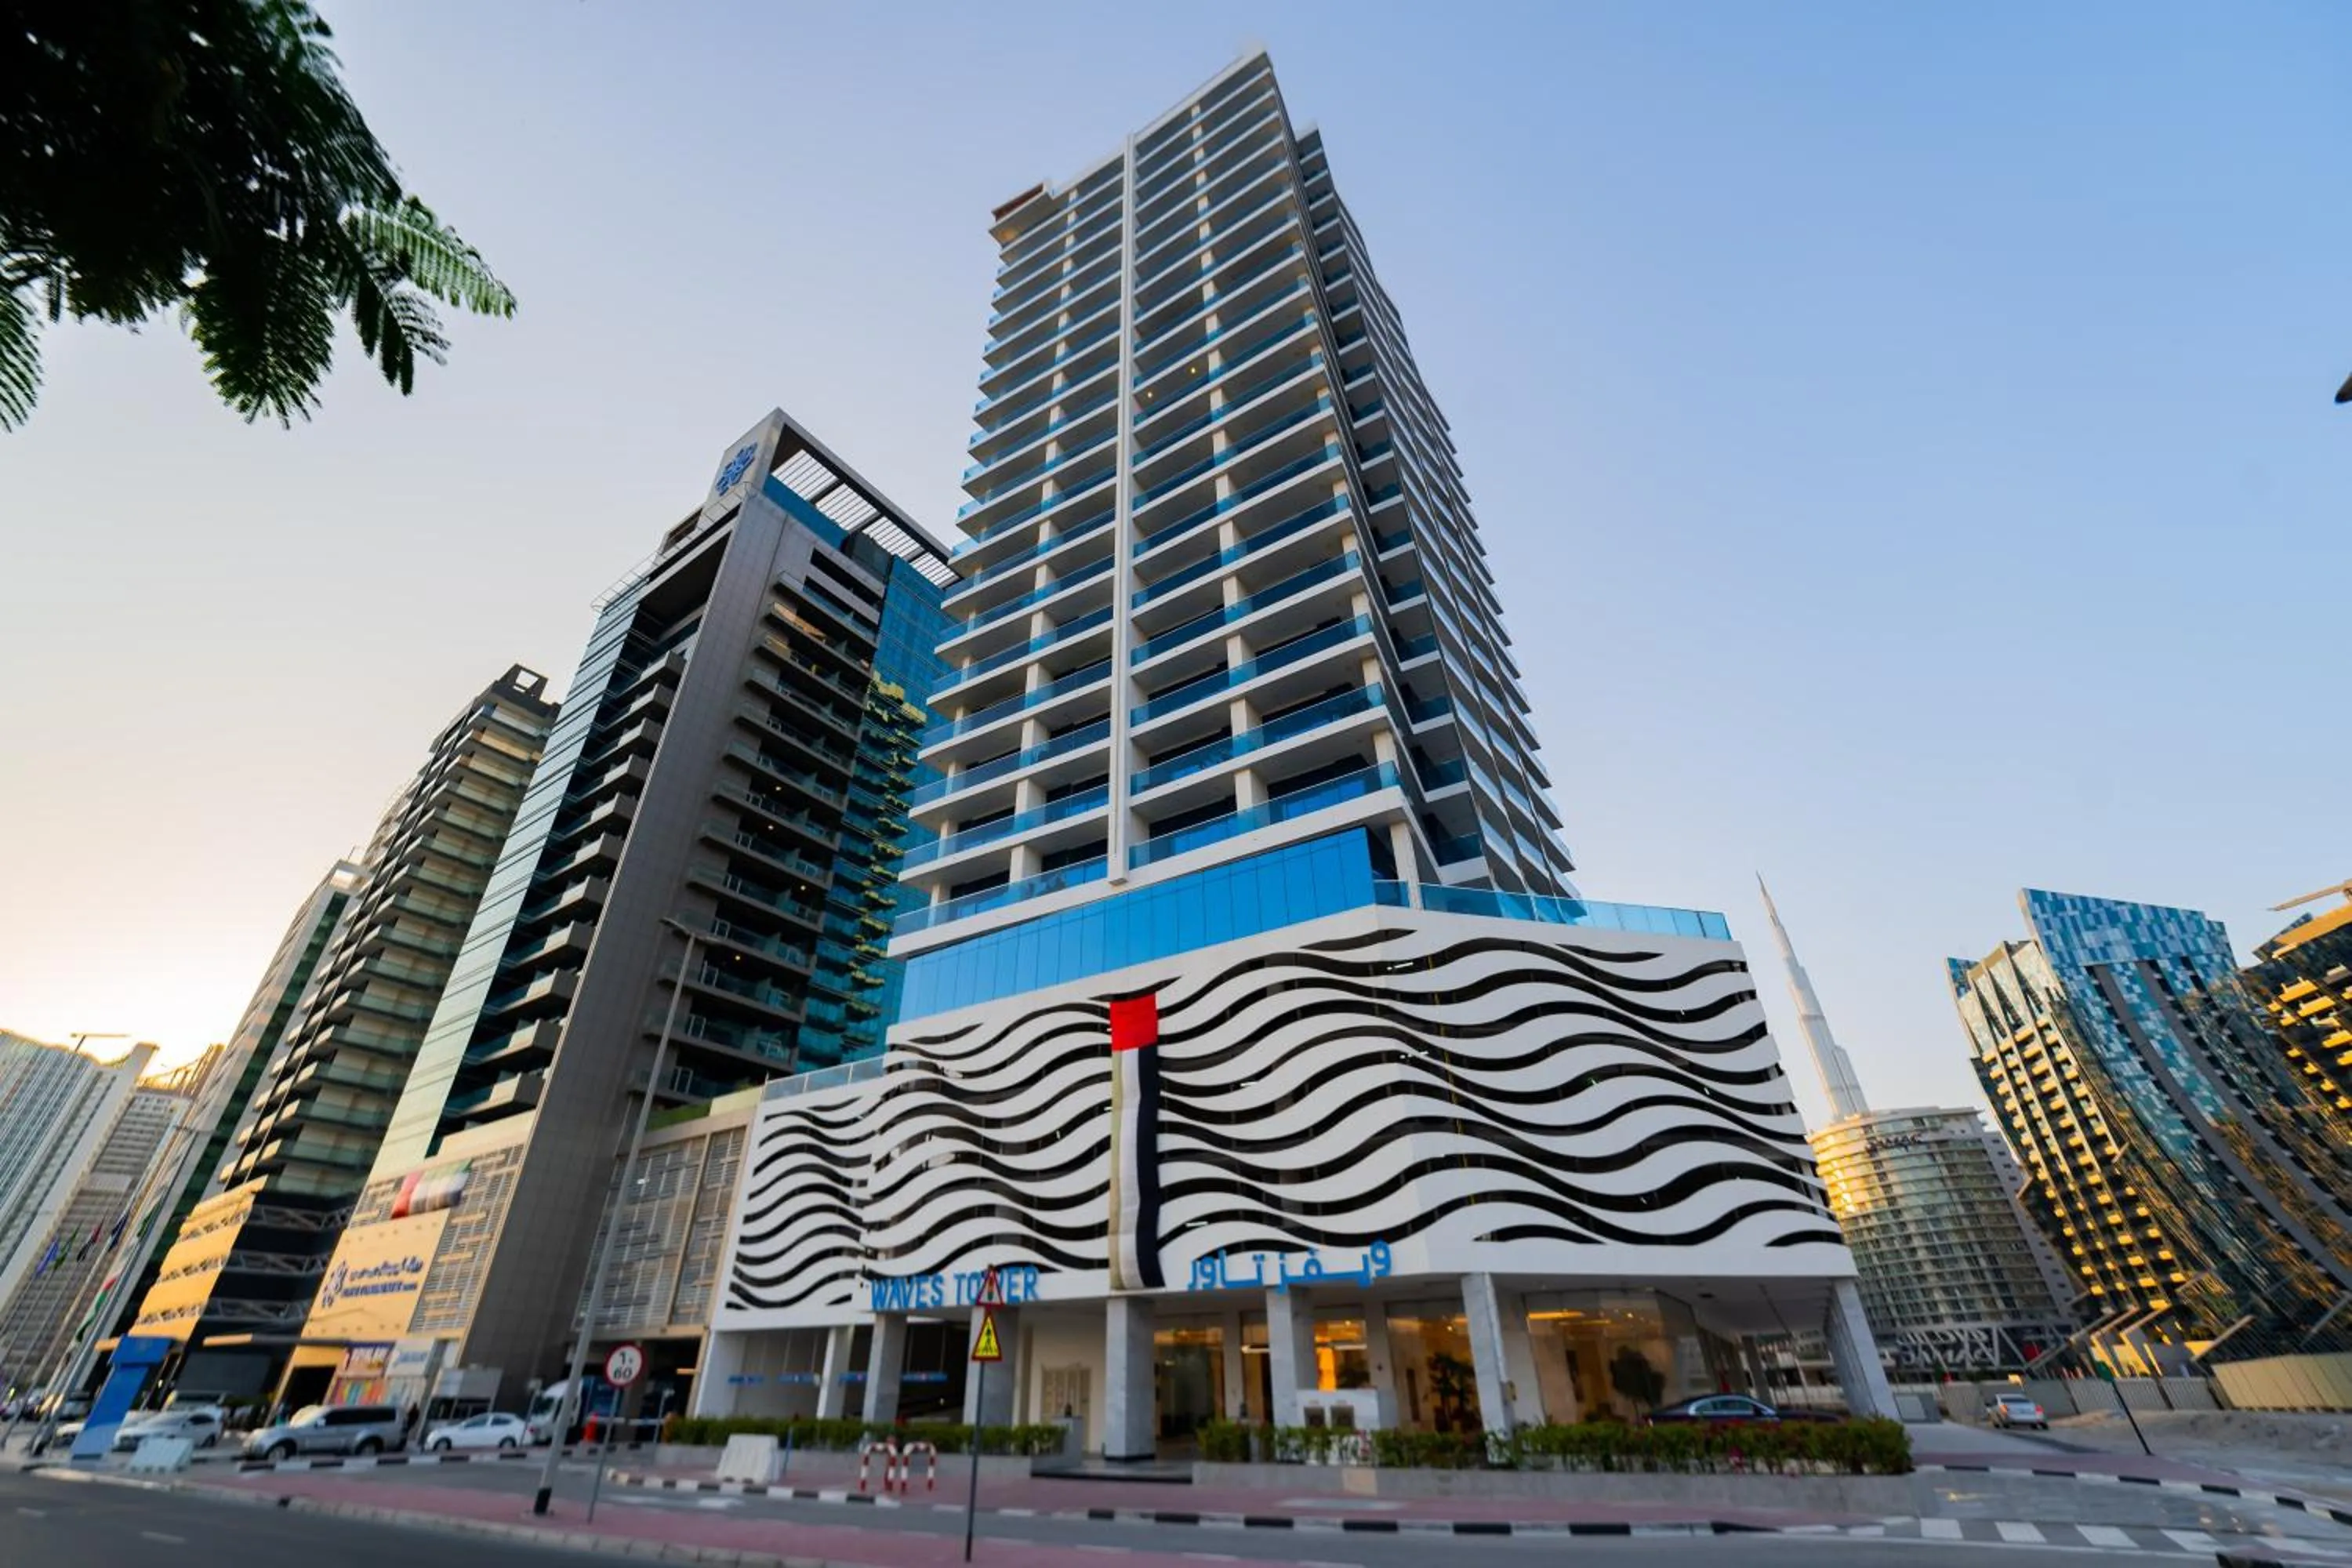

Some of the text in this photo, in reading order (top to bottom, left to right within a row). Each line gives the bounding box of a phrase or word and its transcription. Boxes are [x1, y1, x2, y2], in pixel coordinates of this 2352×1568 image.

[1187, 1247, 1265, 1291] تاور
[871, 1274, 945, 1312] WAVES
[613, 1367, 633, 1381] 60
